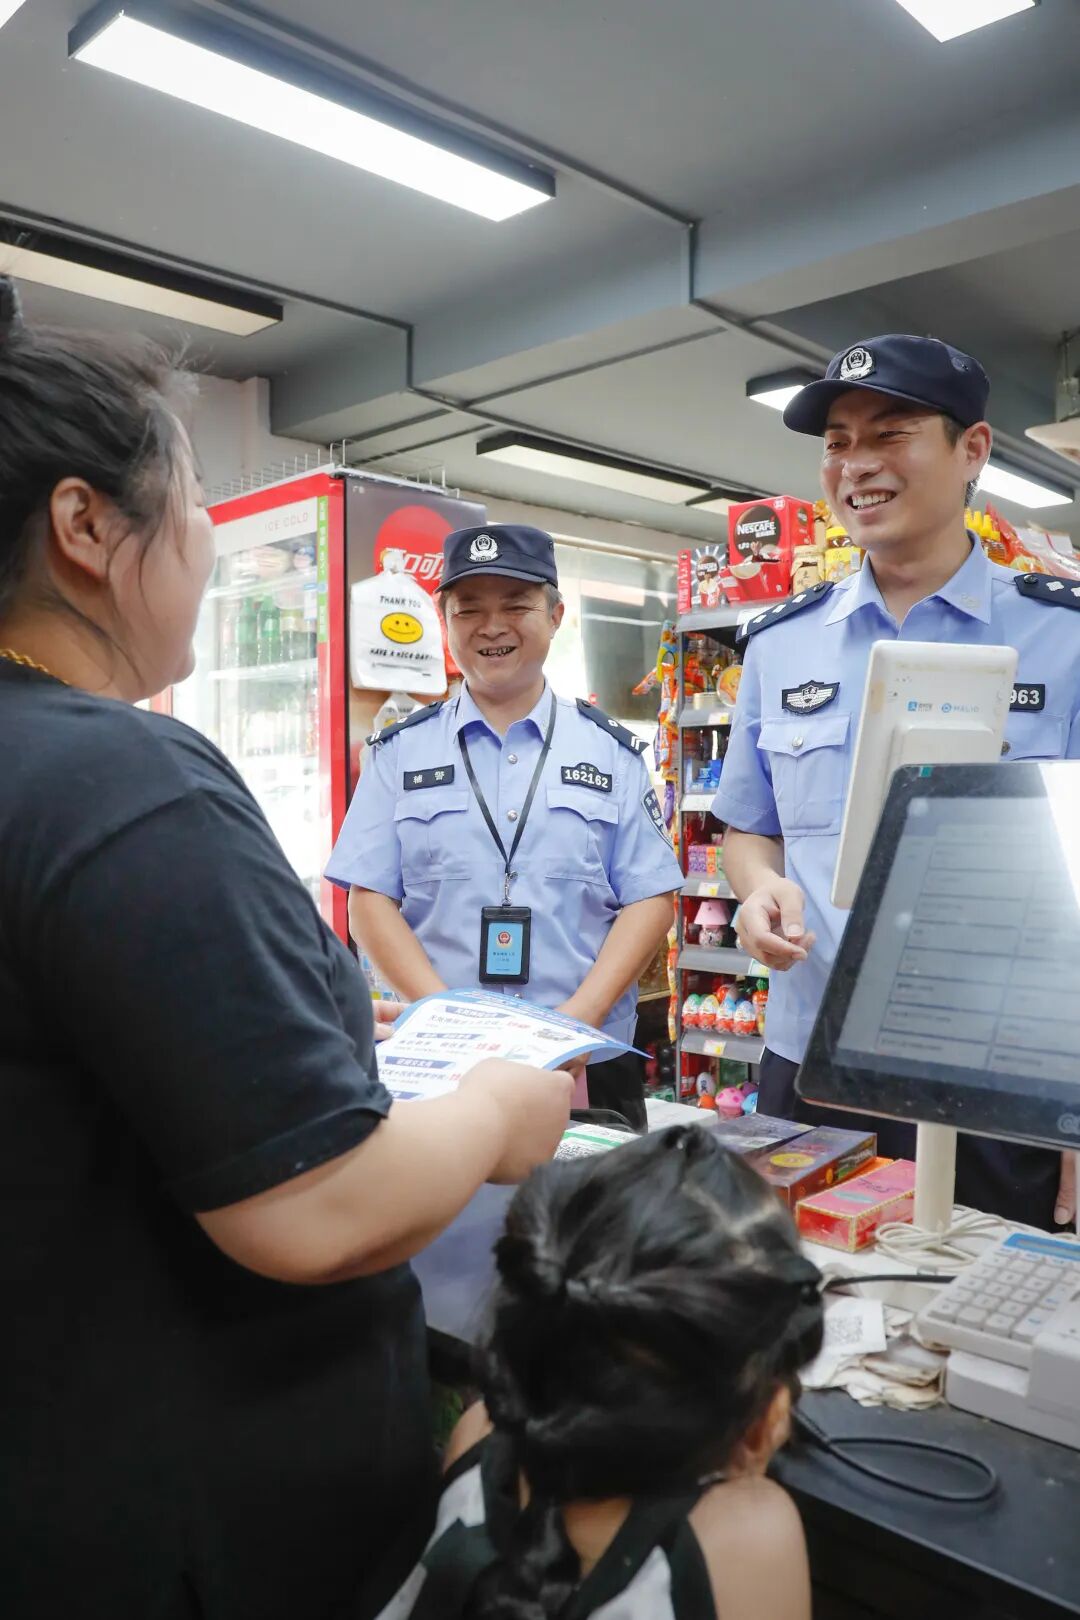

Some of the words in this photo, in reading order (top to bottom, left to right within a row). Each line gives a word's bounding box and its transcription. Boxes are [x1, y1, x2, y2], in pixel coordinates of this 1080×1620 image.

[264, 519, 280, 532] ICE
[283, 511, 308, 528] COLD
[379, 595, 406, 606] THANK
[370, 647, 387, 657] HAVE
[396, 650, 414, 660] NICE
[564, 769, 609, 789] 162162
